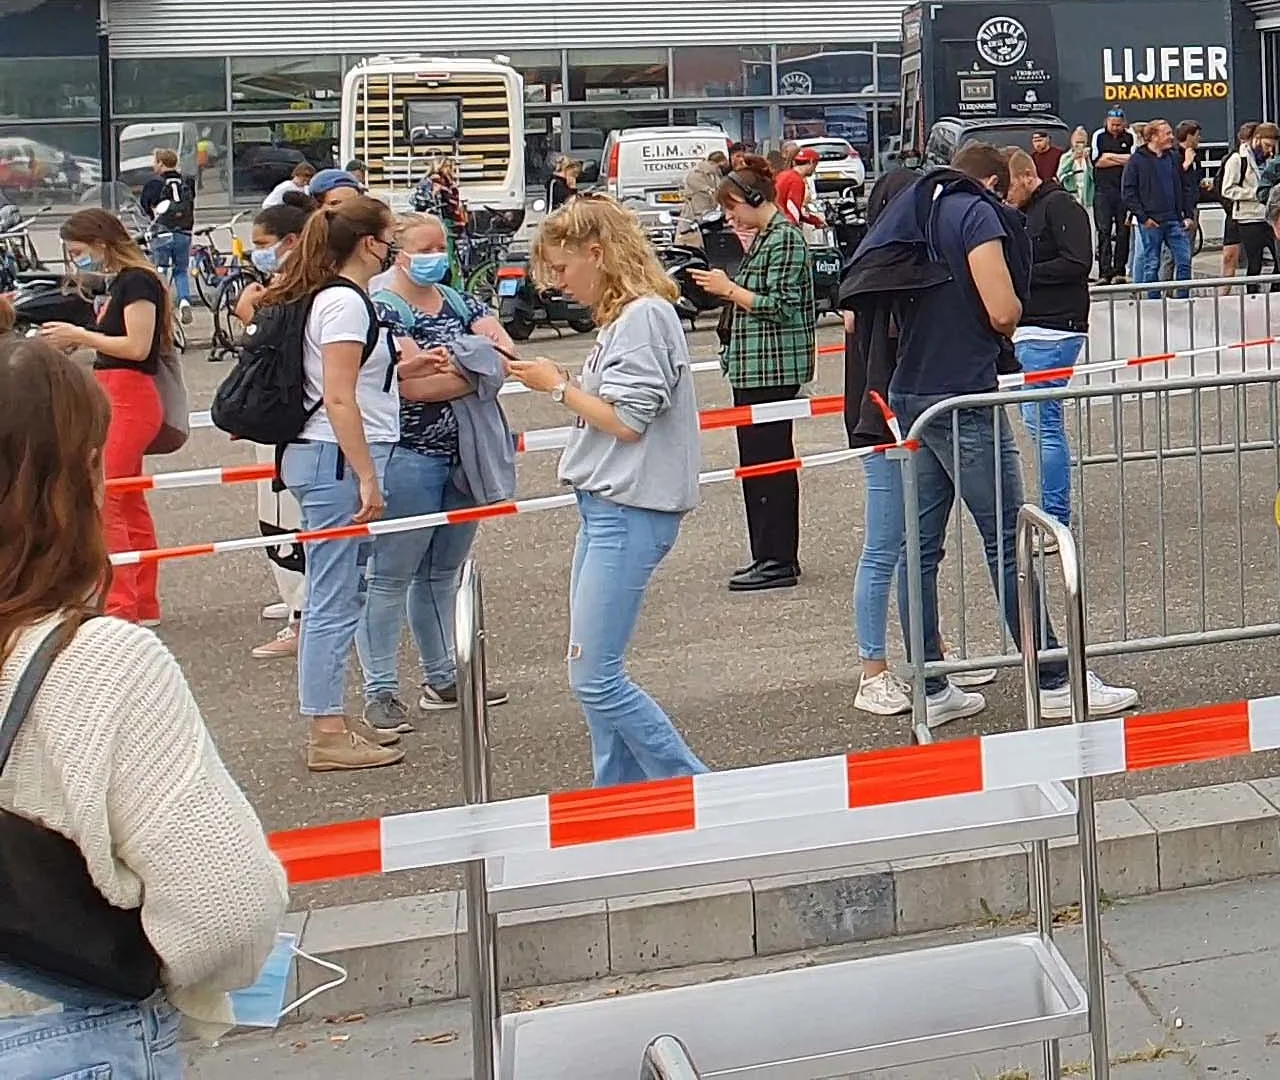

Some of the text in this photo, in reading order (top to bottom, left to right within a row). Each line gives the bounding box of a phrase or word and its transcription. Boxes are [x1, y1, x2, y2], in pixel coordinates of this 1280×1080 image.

[1103, 46, 1228, 83] LIJFER
[1104, 82, 1228, 100] DRANKENGRO
[643, 145, 683, 158] E.I.M.
